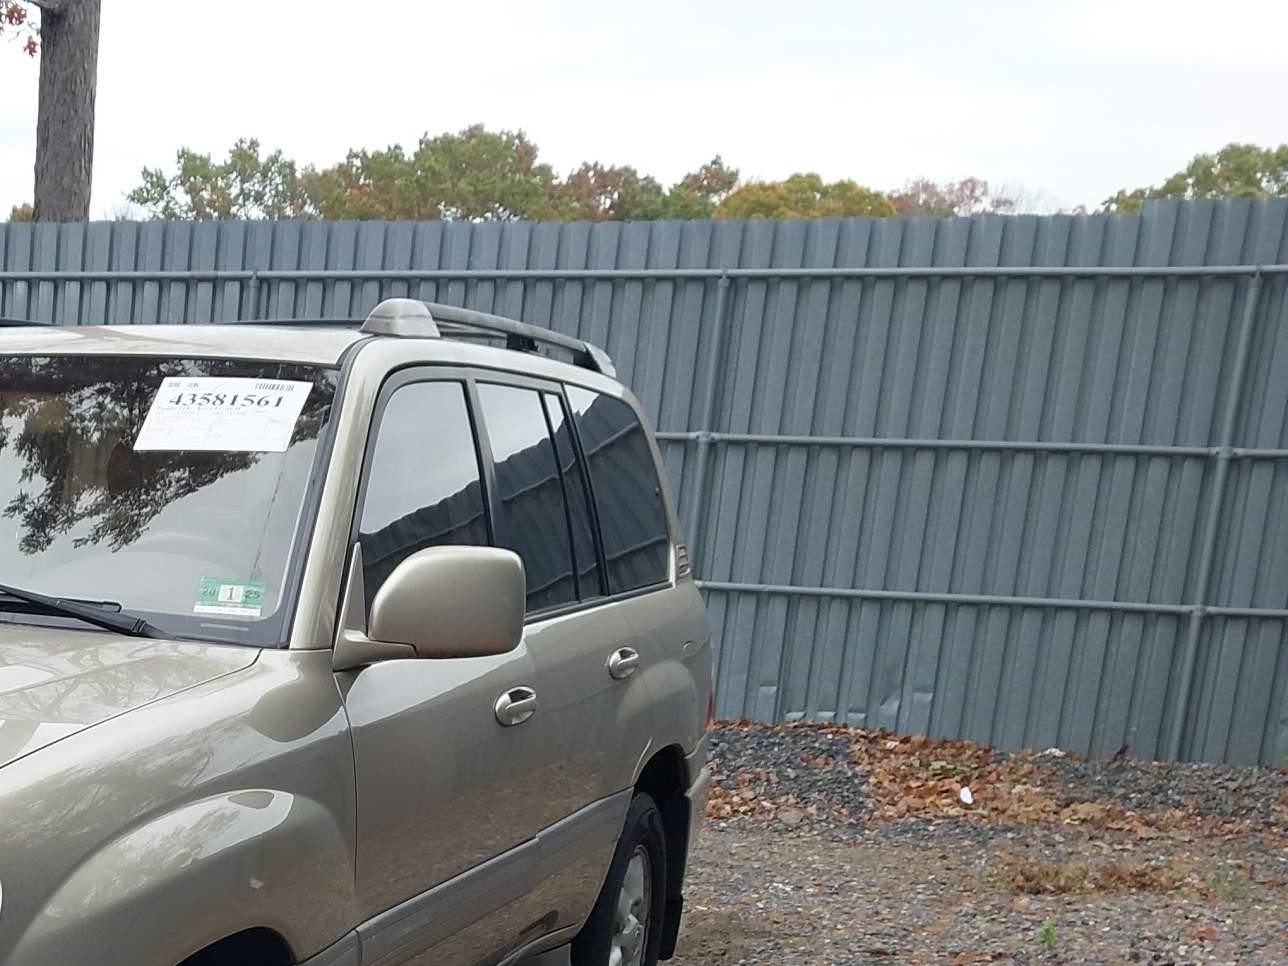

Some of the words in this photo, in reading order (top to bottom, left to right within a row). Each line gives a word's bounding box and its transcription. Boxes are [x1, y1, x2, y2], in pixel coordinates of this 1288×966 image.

[169, 392, 284, 408] 43581561
[226, 587, 234, 601] 1
[245, 590, 262, 600] 25
